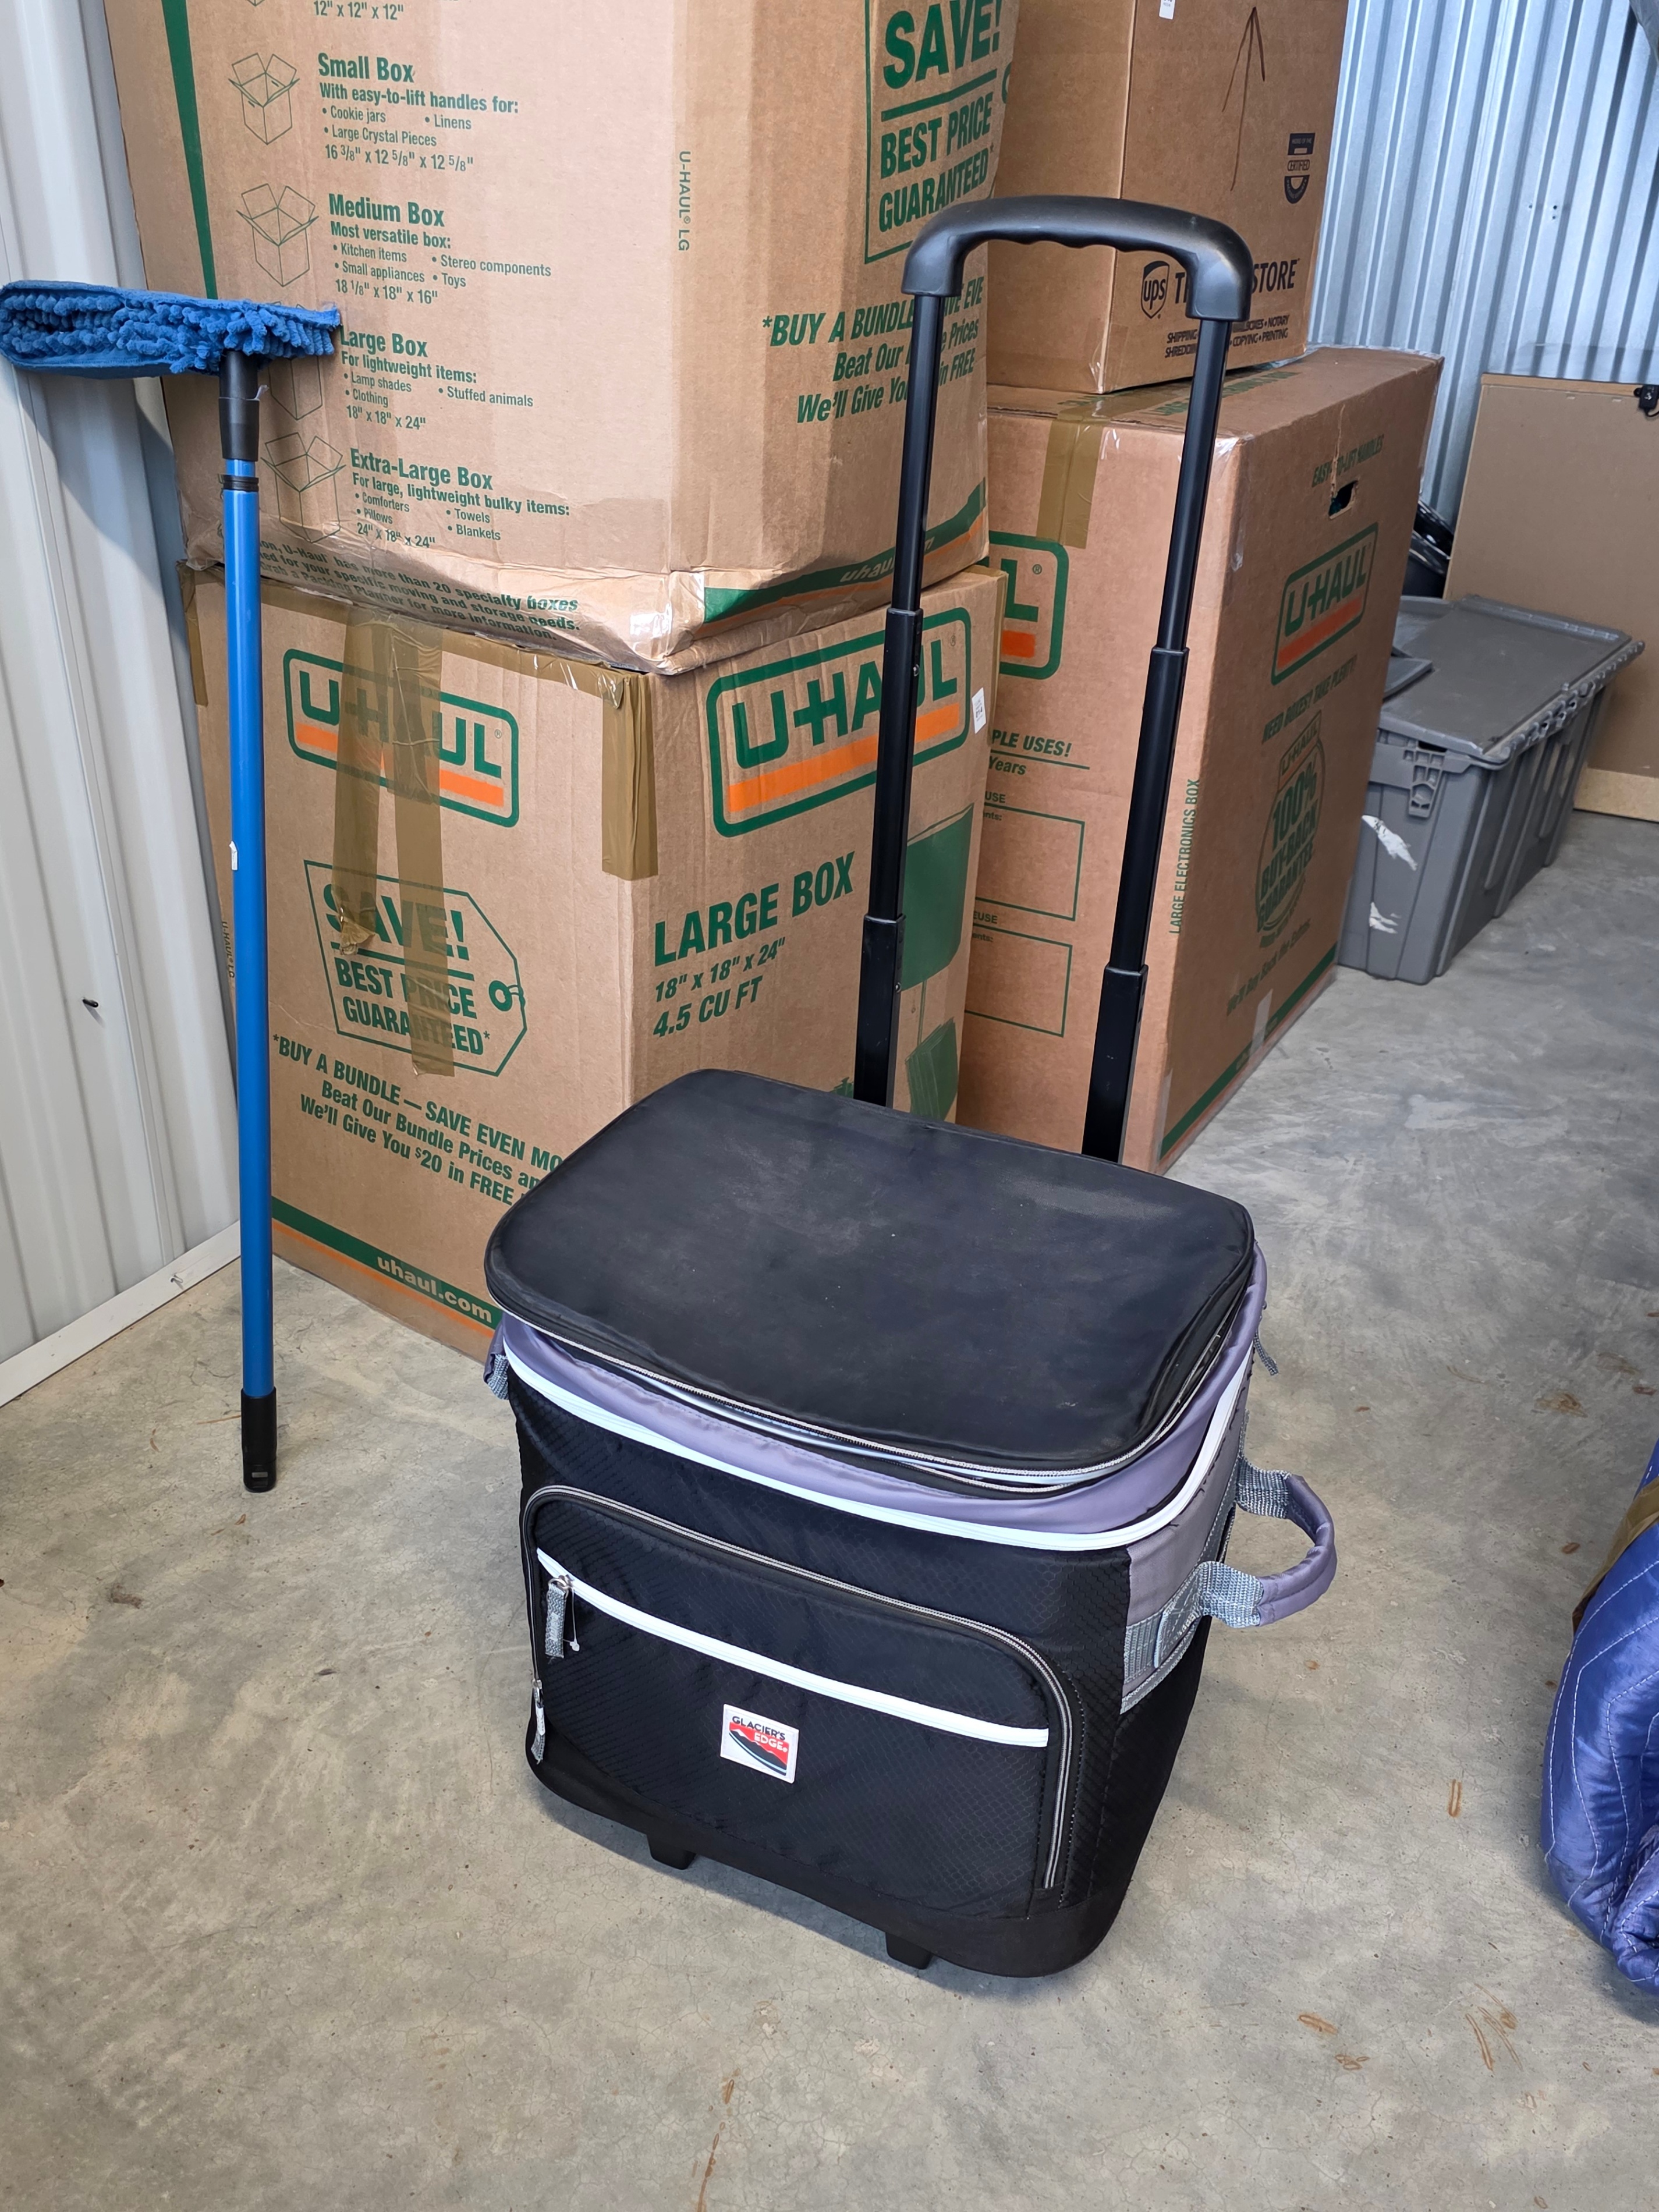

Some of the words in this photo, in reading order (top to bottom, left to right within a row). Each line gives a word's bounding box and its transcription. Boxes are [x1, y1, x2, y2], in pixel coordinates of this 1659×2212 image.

[314, 0, 332, 16] 12"
[336, 5, 344, 17] x
[348, 2, 367, 18] 12"
[371, 6, 379, 19] x
[382, 3, 404, 20] 12"
[883, 0, 1002, 90] SAVE!
[318, 52, 370, 80] Small
[377, 57, 415, 83] Box
[320, 83, 348, 100] With
[352, 85, 426, 107] easy-to-lift
[430, 91, 487, 111] handles
[492, 95, 519, 114] for:
[331, 106, 364, 122] Cookie
[366, 108, 387, 124] jars
[434, 115, 472, 130] Linens
[331, 127, 360, 143] Large
[362, 129, 399, 145] Crystal
[401, 131, 437, 147] Pieces
[881, 116, 942, 179] BEST
[946, 91, 994, 154] PRICE
[325, 144, 339, 160] 16
[374, 148, 389, 164] 12
[431, 153, 446, 170] 12
[328, 193, 401, 222] Medium
[407, 201, 445, 227] Box
[330, 221, 360, 238] Most
[362, 224, 419, 244] versatile
[423, 230, 452, 250] box:
[678, 229, 691, 251] LG
[341, 243, 376, 260] Kitchen
[378, 246, 407, 263] items
[440, 254, 477, 270] Stereo
[479, 258, 552, 278] components
[342, 260, 368, 275] Small
[370, 263, 426, 284] appliances
[442, 272, 466, 288] Toys
[1252, 259, 1298, 294] STORE
[335, 279, 348, 293] 18
[382, 285, 403, 300] 18"
[419, 289, 438, 304] 16"
[340, 323, 386, 353] Large
[392, 332, 428, 357] Box
[828, 311, 846, 343] A
[832, 352, 873, 381] Beat
[875, 343, 903, 372] Our
[948, 319, 979, 349] Prices
[341, 351, 360, 367] For
[362, 353, 433, 380] lightweight
[436, 364, 477, 383] items:
[350, 371, 376, 390] Lamp
[378, 375, 412, 392] shades
[852, 385, 885, 415] Give
[949, 348, 976, 381] FREE
[352, 389, 389, 407] Clothing
[446, 385, 487, 402] Stuffed
[488, 389, 534, 407] animals
[346, 405, 367, 419] 18"
[375, 409, 392, 424] 18"
[405, 414, 426, 430] 24"
[349, 447, 451, 485] Extra-Large
[457, 466, 494, 491] Box
[353, 472, 371, 488] For
[372, 475, 404, 497] large,
[407, 482, 481, 508] lightweight
[484, 494, 522, 513] bulky
[526, 499, 570, 516] items:
[361, 491, 410, 512] Comforters
[357, 522, 374, 536] 24"
[363, 508, 394, 524] Pillows
[454, 508, 491, 523] Towels
[456, 524, 501, 541] Blankets
[281, 555, 300, 568] for
[302, 562, 331, 576] your
[334, 569, 386, 590] specific
[388, 583, 439, 603] moving
[441, 595, 467, 609] and
[470, 602, 526, 623] storage
[528, 614, 580, 631] needs.
[334, 556, 359, 571] has
[361, 563, 396, 580] more
[398, 572, 430, 589] than
[433, 582, 452, 594] 20
[455, 587, 521, 611] specialty
[526, 595, 579, 611] boxes
[1285, 545, 1369, 637] U-HAUL
[407, 597, 427, 611] for
[430, 605, 466, 620] more
[469, 613, 557, 640] information.
[1023, 735, 1073, 757] USES!
[988, 756, 1027, 775] Years
[1186, 778, 1200, 804] BOX
[1272, 753, 1318, 851] 100%
[1174, 808, 1196, 893] ELECTRONICS
[655, 882, 779, 967] LARGE
[792, 850, 856, 918] BOX
[1169, 895, 1187, 935] LARGE
[655, 973, 687, 1002] 18"
[690, 972, 704, 991] x
[710, 955, 740, 984] 18"
[742, 953, 755, 972] x
[757, 937, 786, 966] 24"
[334, 956, 394, 999] BEST
[400, 973, 477, 1019] PRICE
[653, 1002, 692, 1037] 4.5
[699, 988, 731, 1023] CU
[735, 975, 764, 1009] FT
[316, 1053, 328, 1074] A
[334, 1059, 401, 1106] BUNDLE
[426, 1101, 472, 1137] SAVE
[477, 1123, 526, 1161] EVEN
[322, 1080, 358, 1111] Beat
[362, 1098, 392, 1125] Our
[395, 1112, 453, 1154] Bundle
[459, 1142, 513, 1181] Prices
[342, 1114, 377, 1143] Give
[381, 1130, 411, 1160] You
[414, 1147, 442, 1173] $20
[448, 1161, 465, 1183] in
[470, 1171, 515, 1206] FREE
[377, 1256, 492, 1323] uhaul.com
[732, 1716, 786, 1741] GLACIER'S
